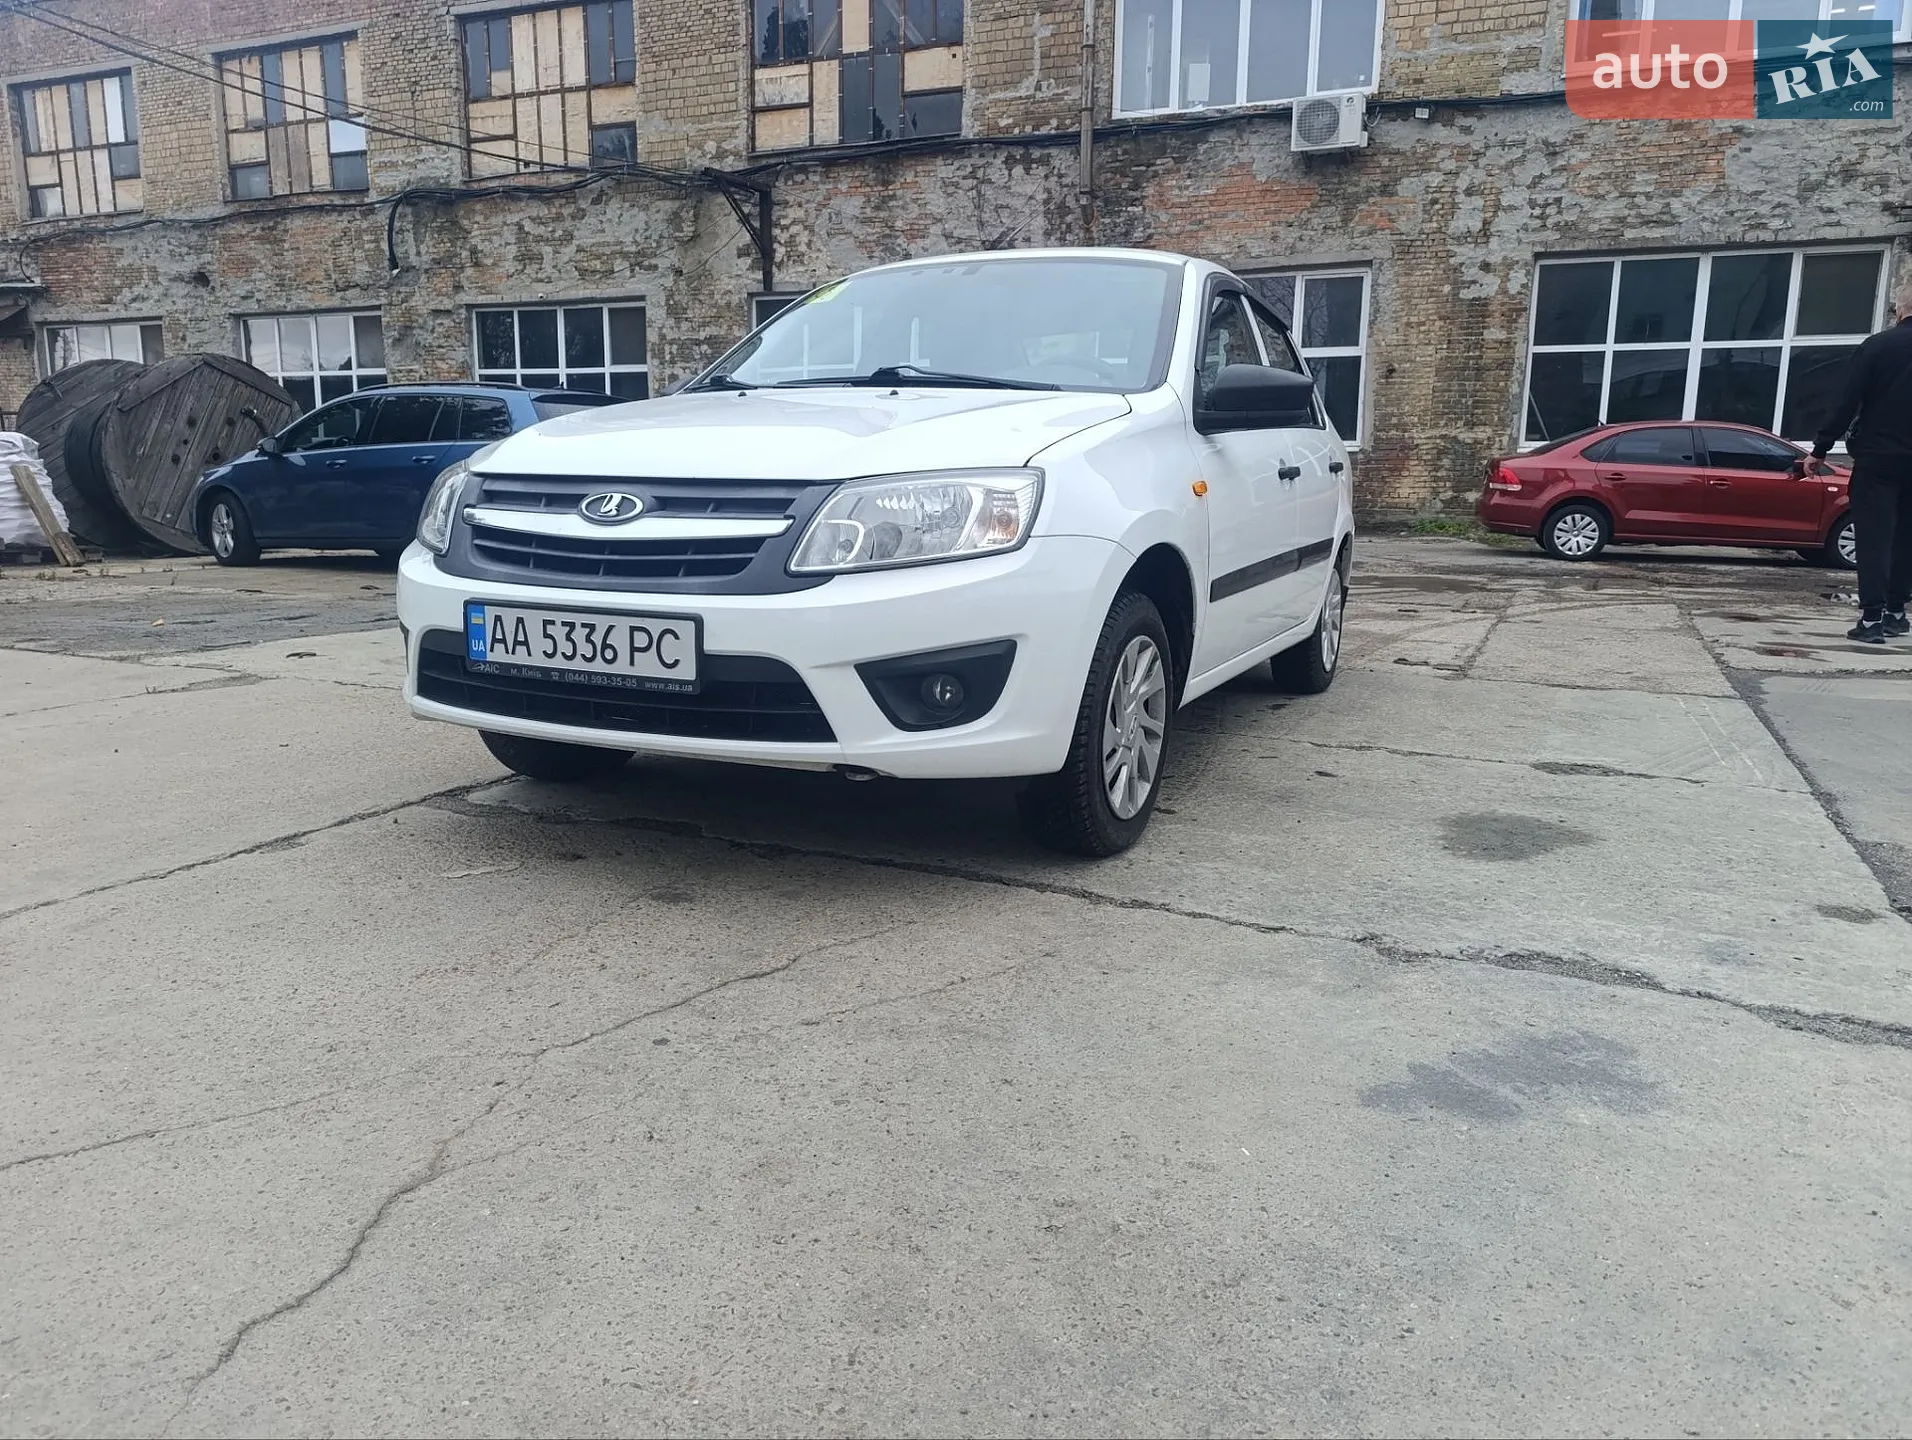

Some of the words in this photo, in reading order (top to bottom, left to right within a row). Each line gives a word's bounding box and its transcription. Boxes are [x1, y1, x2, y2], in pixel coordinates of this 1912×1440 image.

[472, 639, 486, 652] UA
[489, 614, 532, 657] AA
[542, 618, 618, 665] 5336
[628, 624, 681, 670] PC
